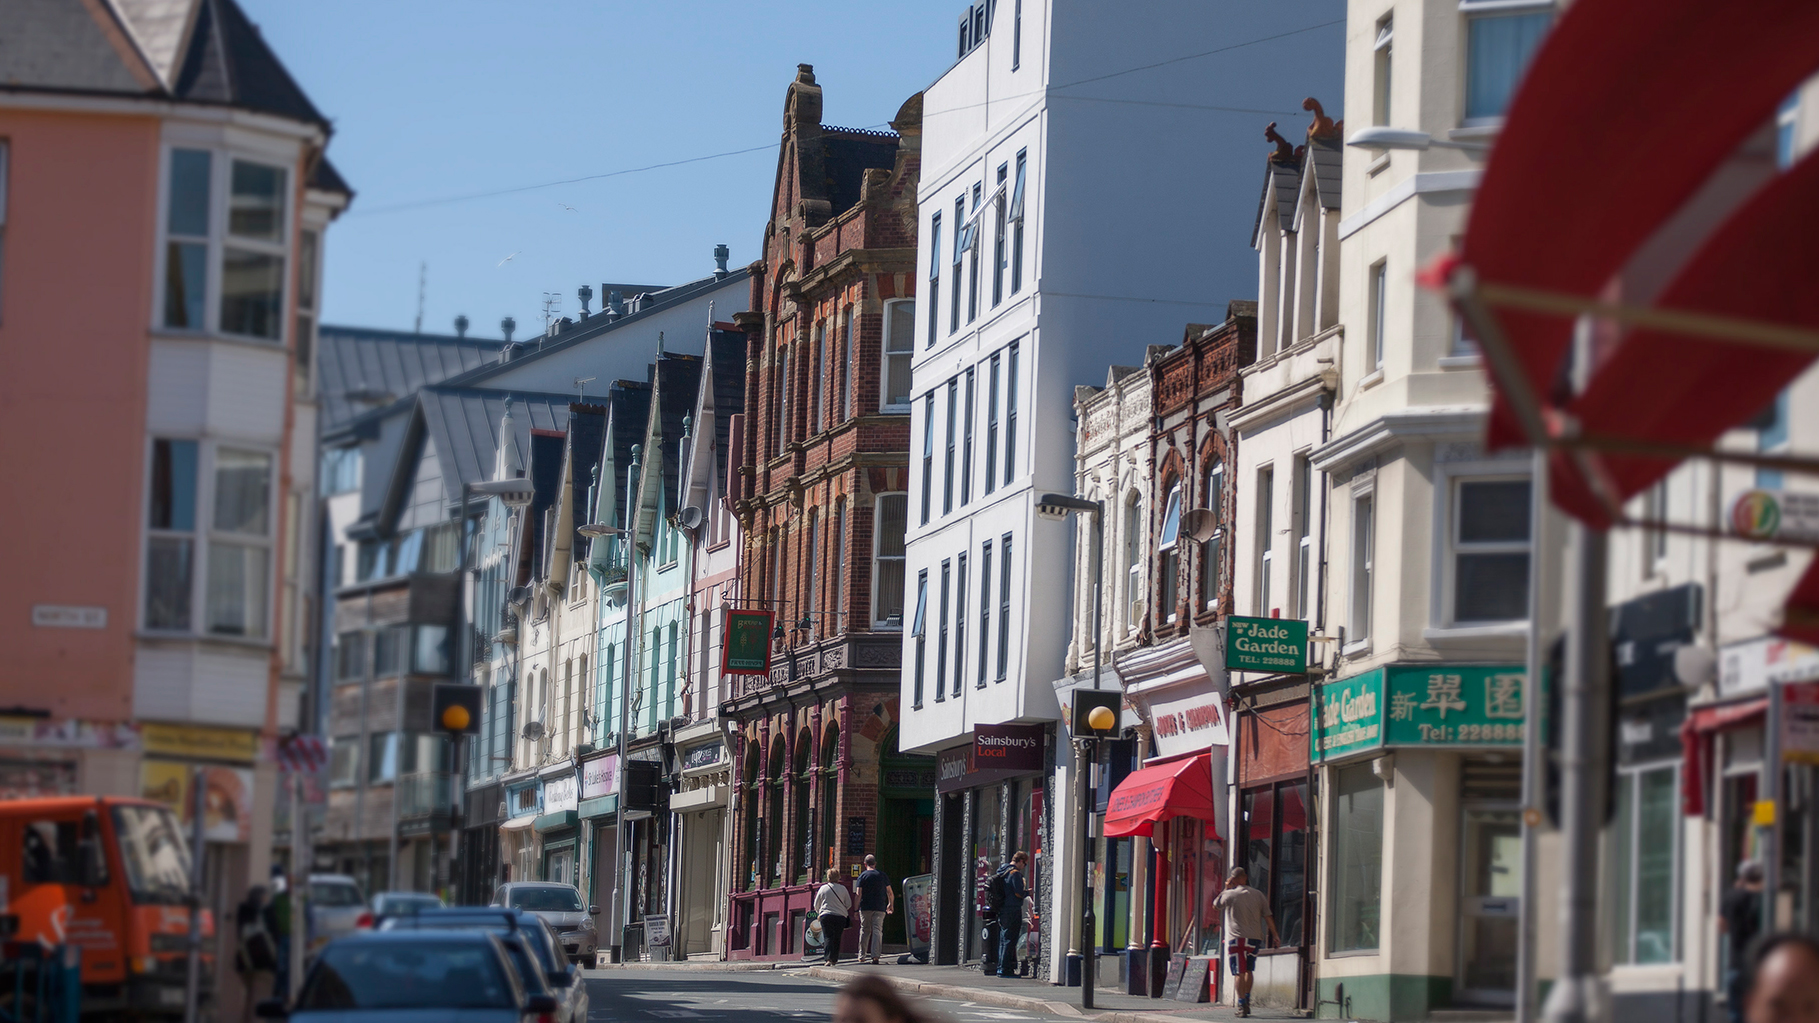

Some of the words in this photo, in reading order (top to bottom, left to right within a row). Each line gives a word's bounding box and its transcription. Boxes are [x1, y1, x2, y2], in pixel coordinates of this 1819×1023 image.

[1247, 623, 1288, 639] Jade
[1235, 637, 1299, 655] Garden
[1238, 655, 1260, 664] TEL:
[1262, 657, 1296, 666] 228888
[1341, 684, 1376, 723] Garden
[1418, 723, 1453, 741] Tel:
[977, 735, 1036, 749] Sainsbury's
[977, 746, 1006, 757] Local
[941, 753, 966, 781] Sainsbury's
